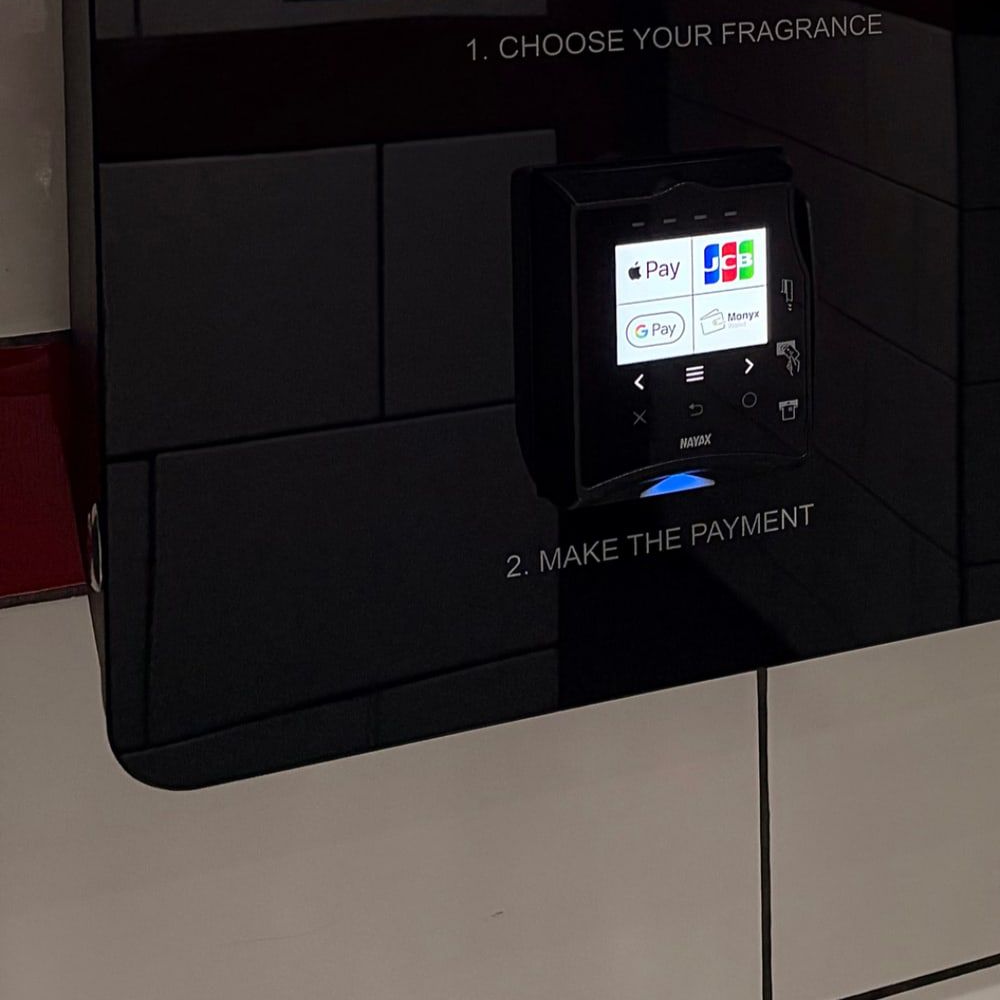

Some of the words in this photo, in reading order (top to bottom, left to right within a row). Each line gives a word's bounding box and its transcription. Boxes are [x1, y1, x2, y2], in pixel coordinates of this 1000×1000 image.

[466, 39, 488, 61] 1.
[499, 29, 625, 60] CHOOSE
[633, 24, 713, 50] YOUR
[722, 13, 882, 44] FRAGRANCE
[646, 261, 680, 280] Pay
[727, 310, 760, 322] Monyx
[652, 322, 676, 338] Pay
[680, 433, 712, 449] NAYAX
[506, 555, 529, 578] 2.
[539, 537, 619, 572] MAKE
[627, 526, 682, 556] THE
[691, 503, 814, 546] PAYMENT
